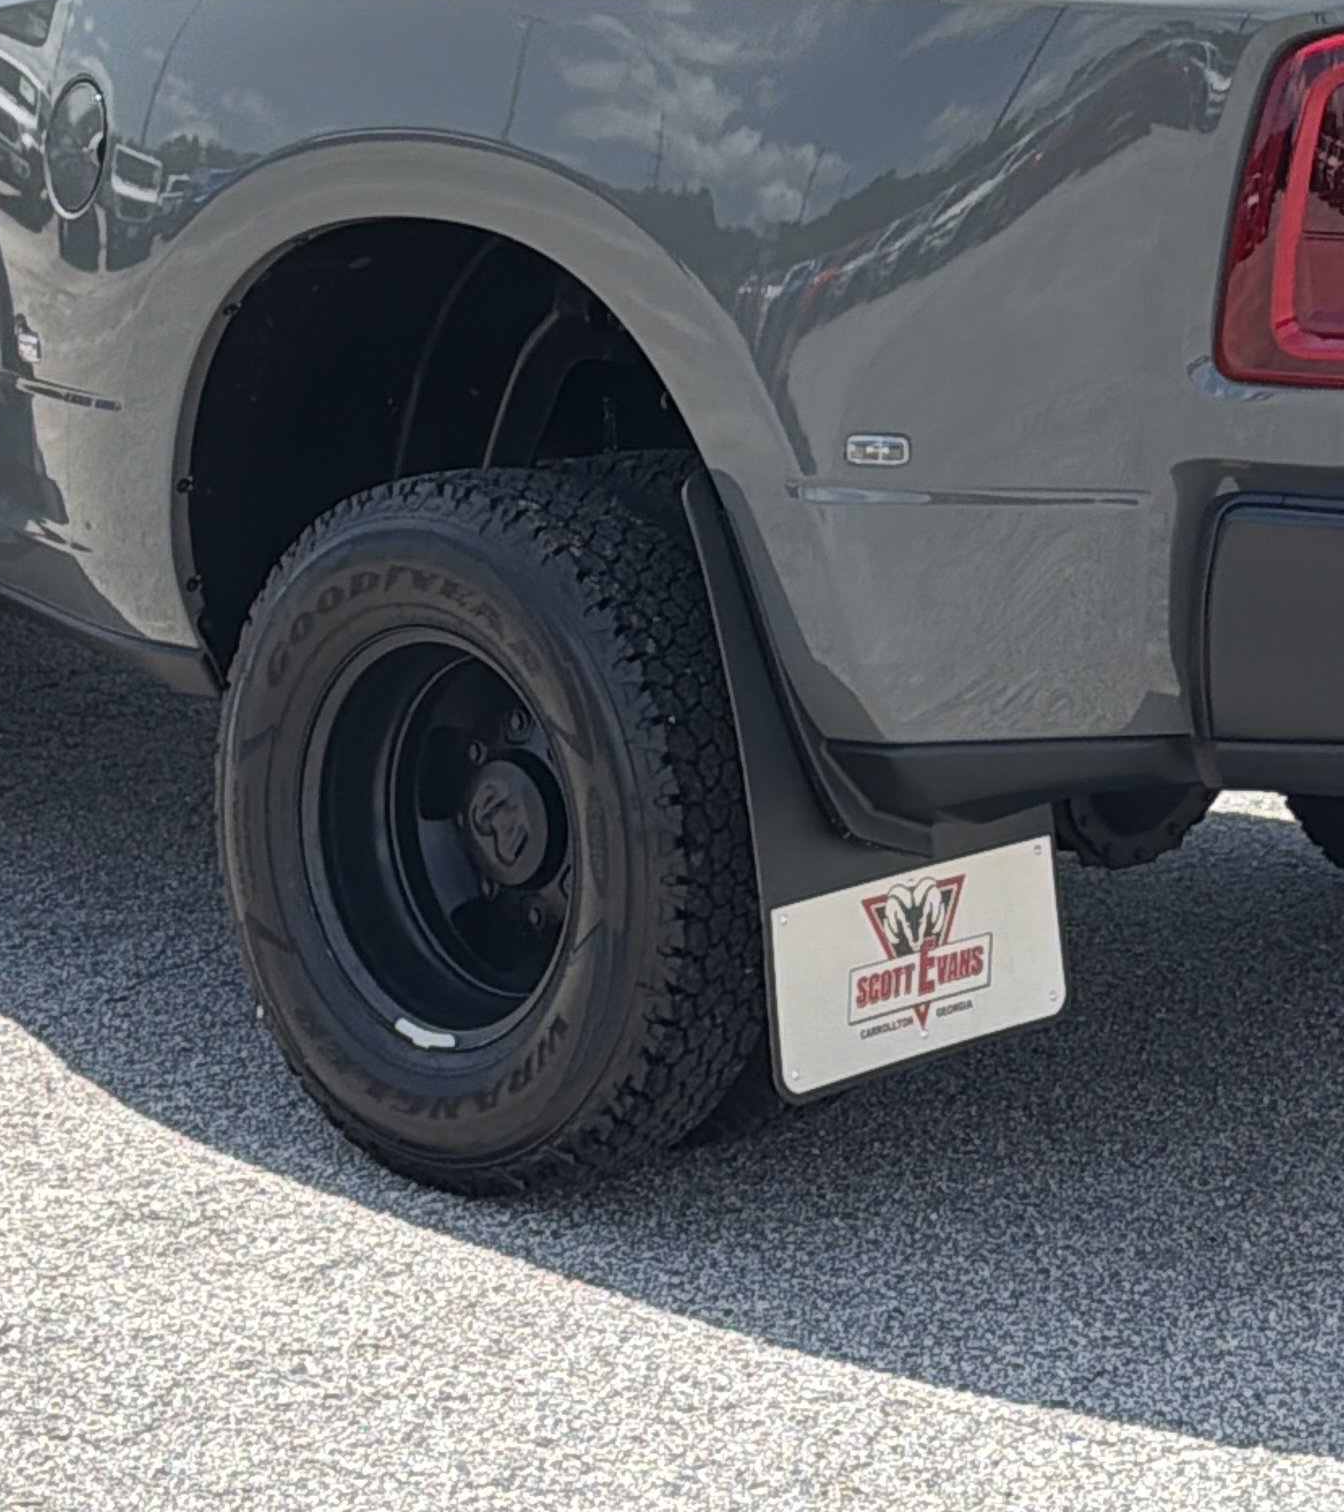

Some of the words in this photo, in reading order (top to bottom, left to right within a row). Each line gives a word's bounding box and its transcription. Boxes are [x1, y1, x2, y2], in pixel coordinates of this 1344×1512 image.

[266, 564, 543, 688] GOODYEAR
[856, 962, 916, 1008] SCOTT
[918, 936, 984, 996] EVANS
[859, 1016, 914, 1039] CARROLLTON
[935, 999, 973, 1018] GEORGIA
